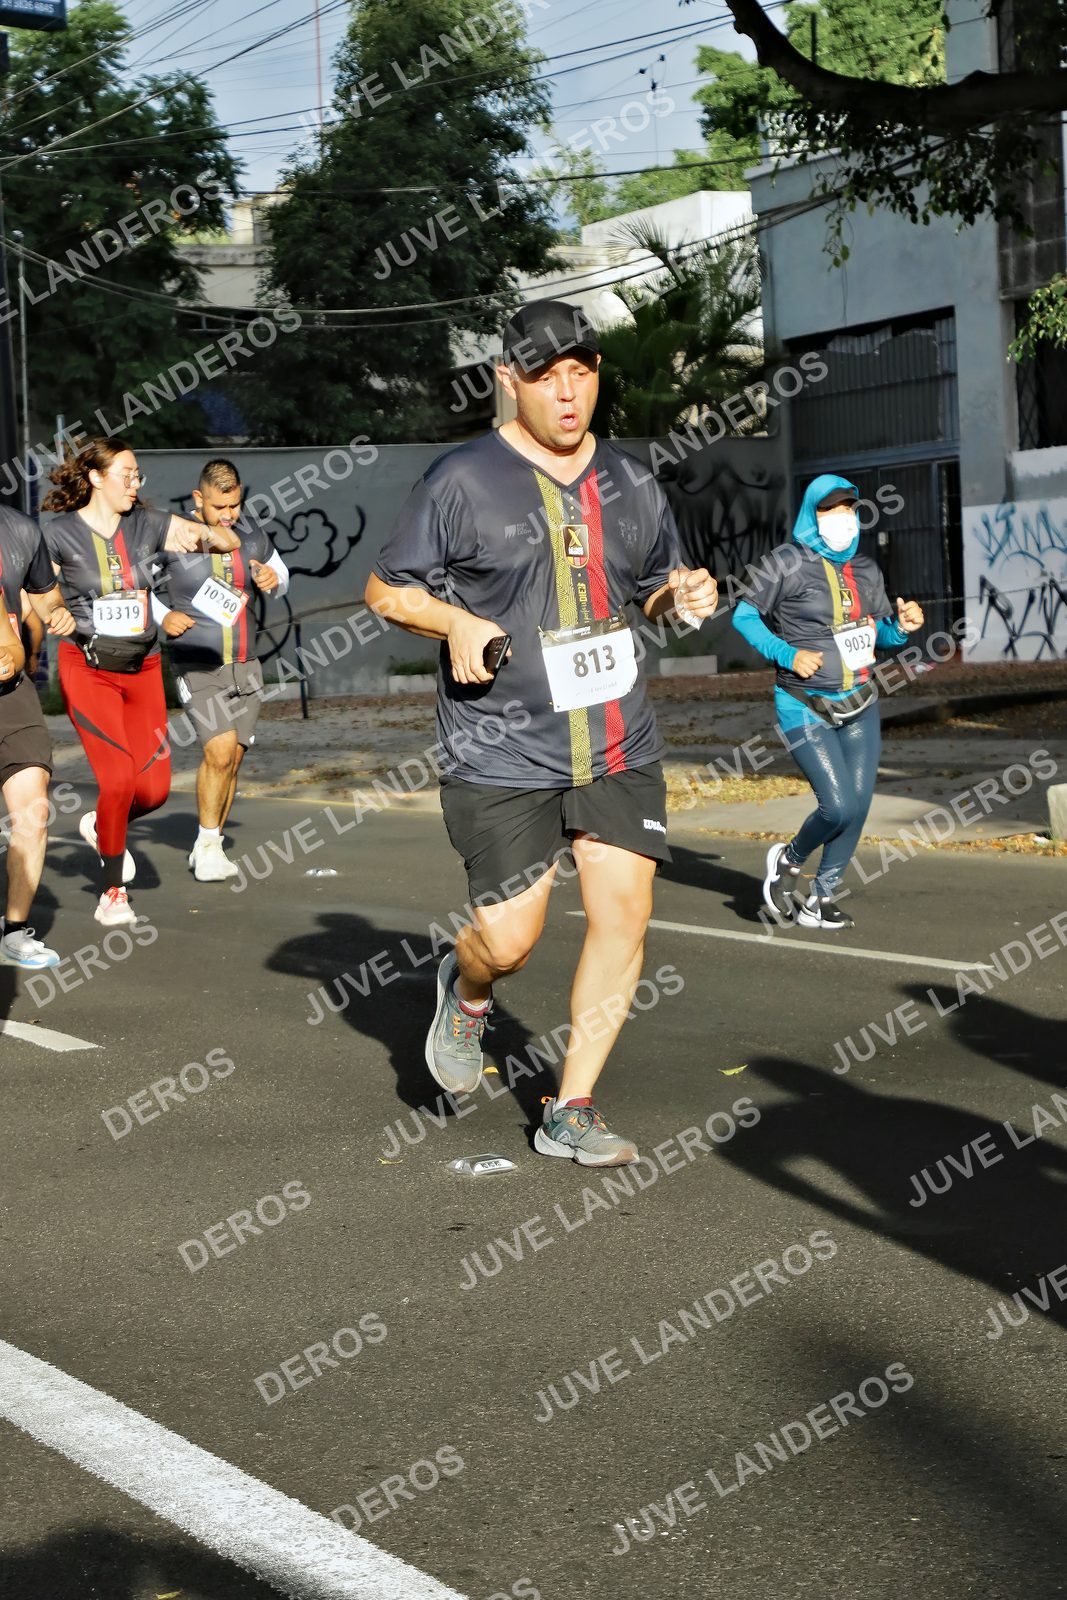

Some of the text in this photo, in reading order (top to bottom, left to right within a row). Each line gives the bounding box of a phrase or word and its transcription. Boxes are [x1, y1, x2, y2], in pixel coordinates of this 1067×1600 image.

[202, 584, 238, 613] 10260
[96, 604, 140, 621] 13319
[844, 633, 871, 653] 9032
[572, 644, 616, 678] 813
